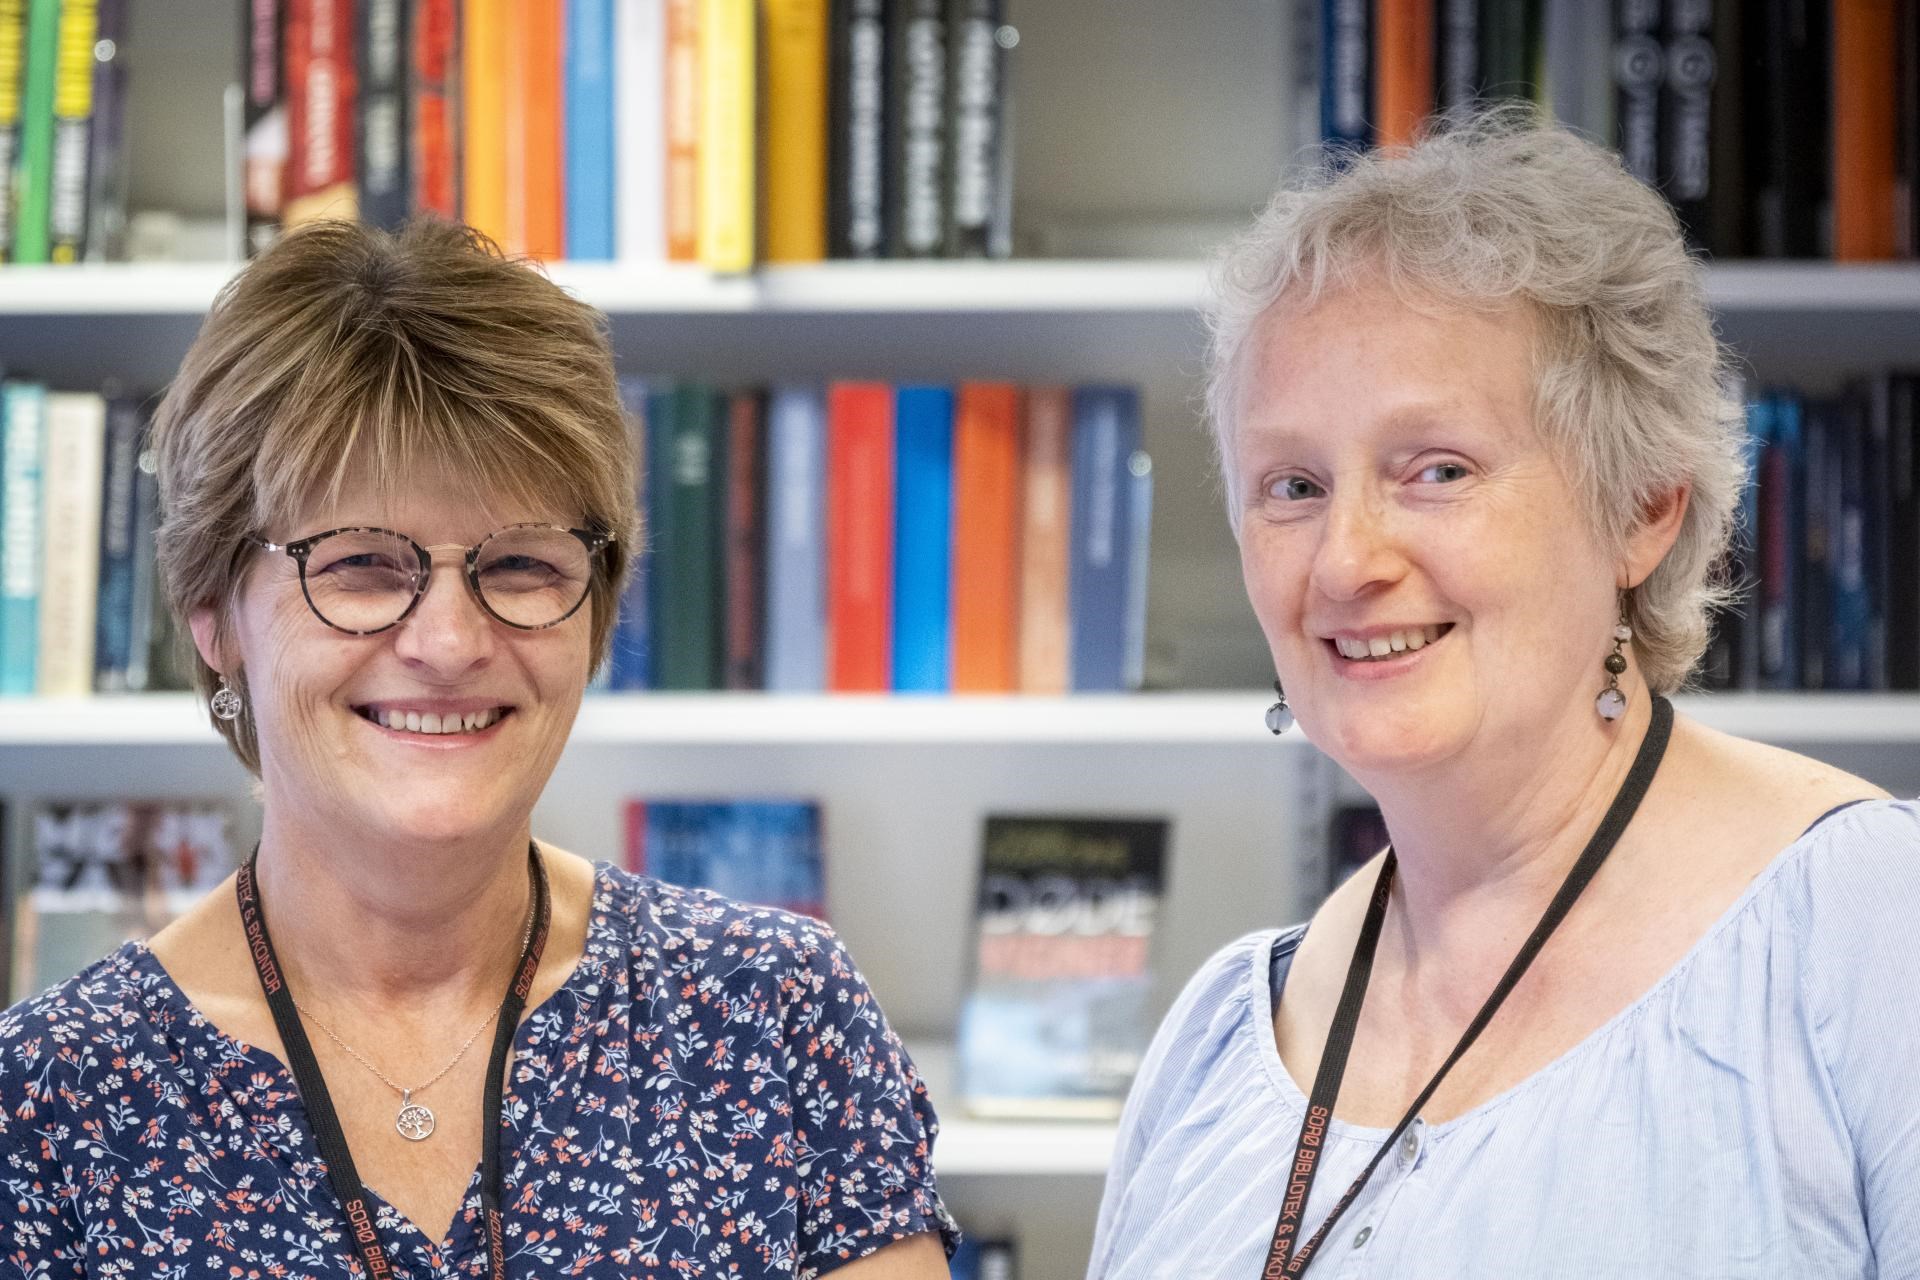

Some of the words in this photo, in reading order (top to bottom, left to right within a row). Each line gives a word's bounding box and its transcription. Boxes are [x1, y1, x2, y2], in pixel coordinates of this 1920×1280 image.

[244, 907, 256, 921] &
[247, 920, 281, 996] BYKONTOR
[515, 955, 537, 1000] SORØ
[1303, 1105, 1328, 1146] SORØ
[1282, 1148, 1316, 1220] BIBLIOTEK
[346, 1199, 376, 1243] SORØ
[364, 1245, 392, 1280] BIBL
[1278, 1224, 1294, 1236] &
